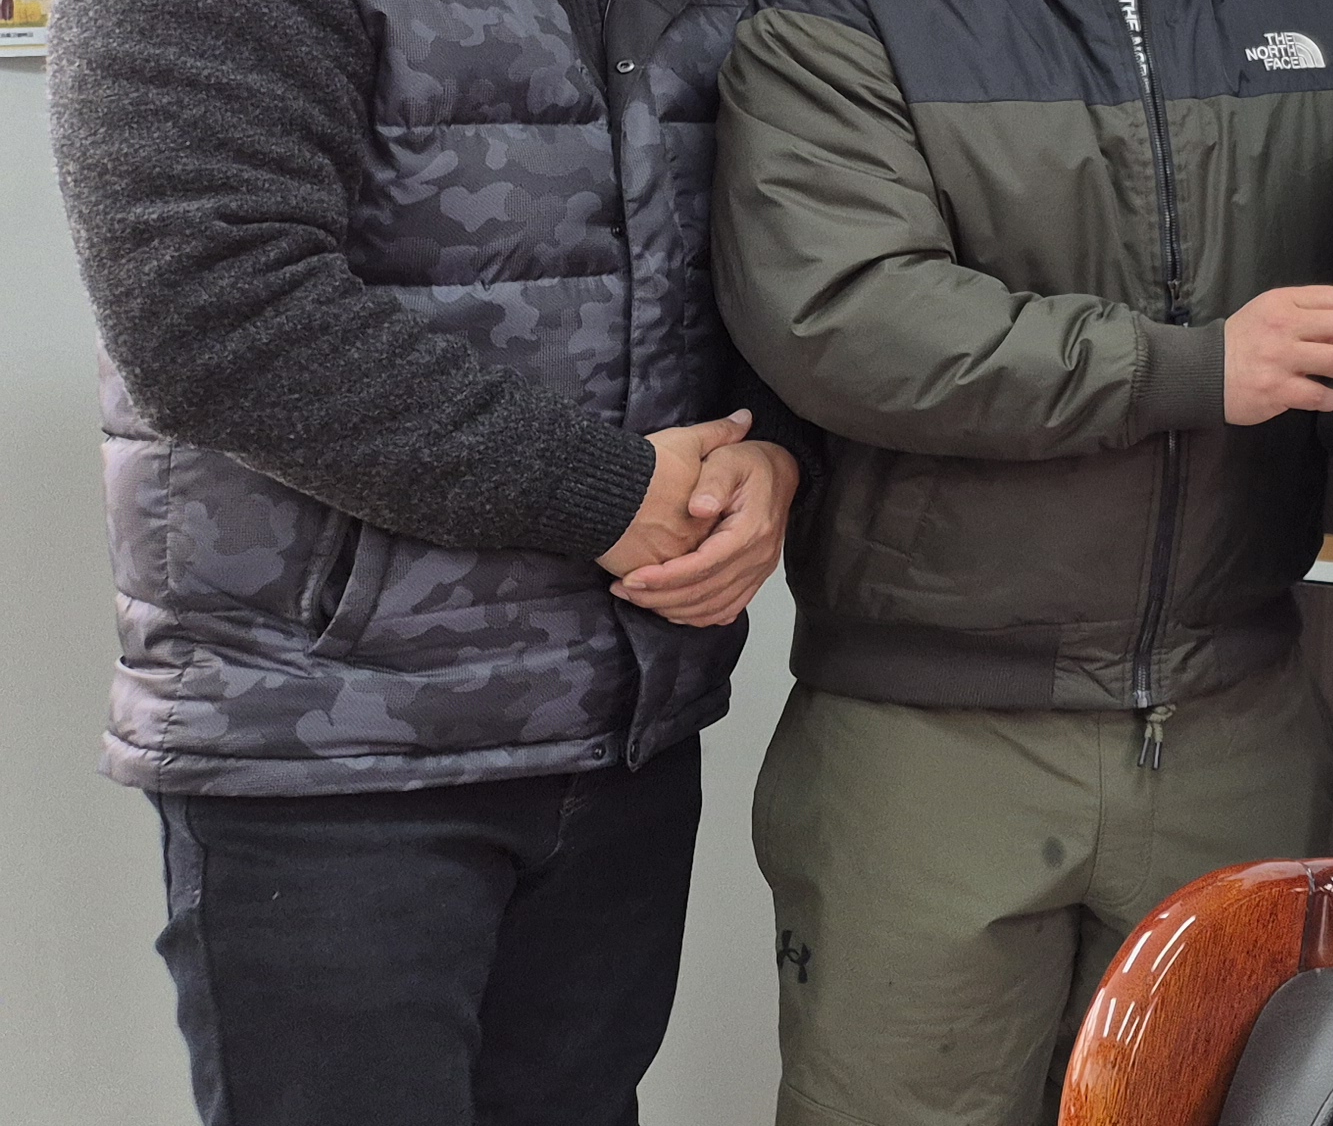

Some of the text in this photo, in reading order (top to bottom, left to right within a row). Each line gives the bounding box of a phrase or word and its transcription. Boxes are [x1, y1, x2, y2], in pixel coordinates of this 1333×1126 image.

[1263, 32, 1296, 46] THE
[1244, 43, 1298, 62] NORTH
[1263, 56, 1301, 71] FACE
